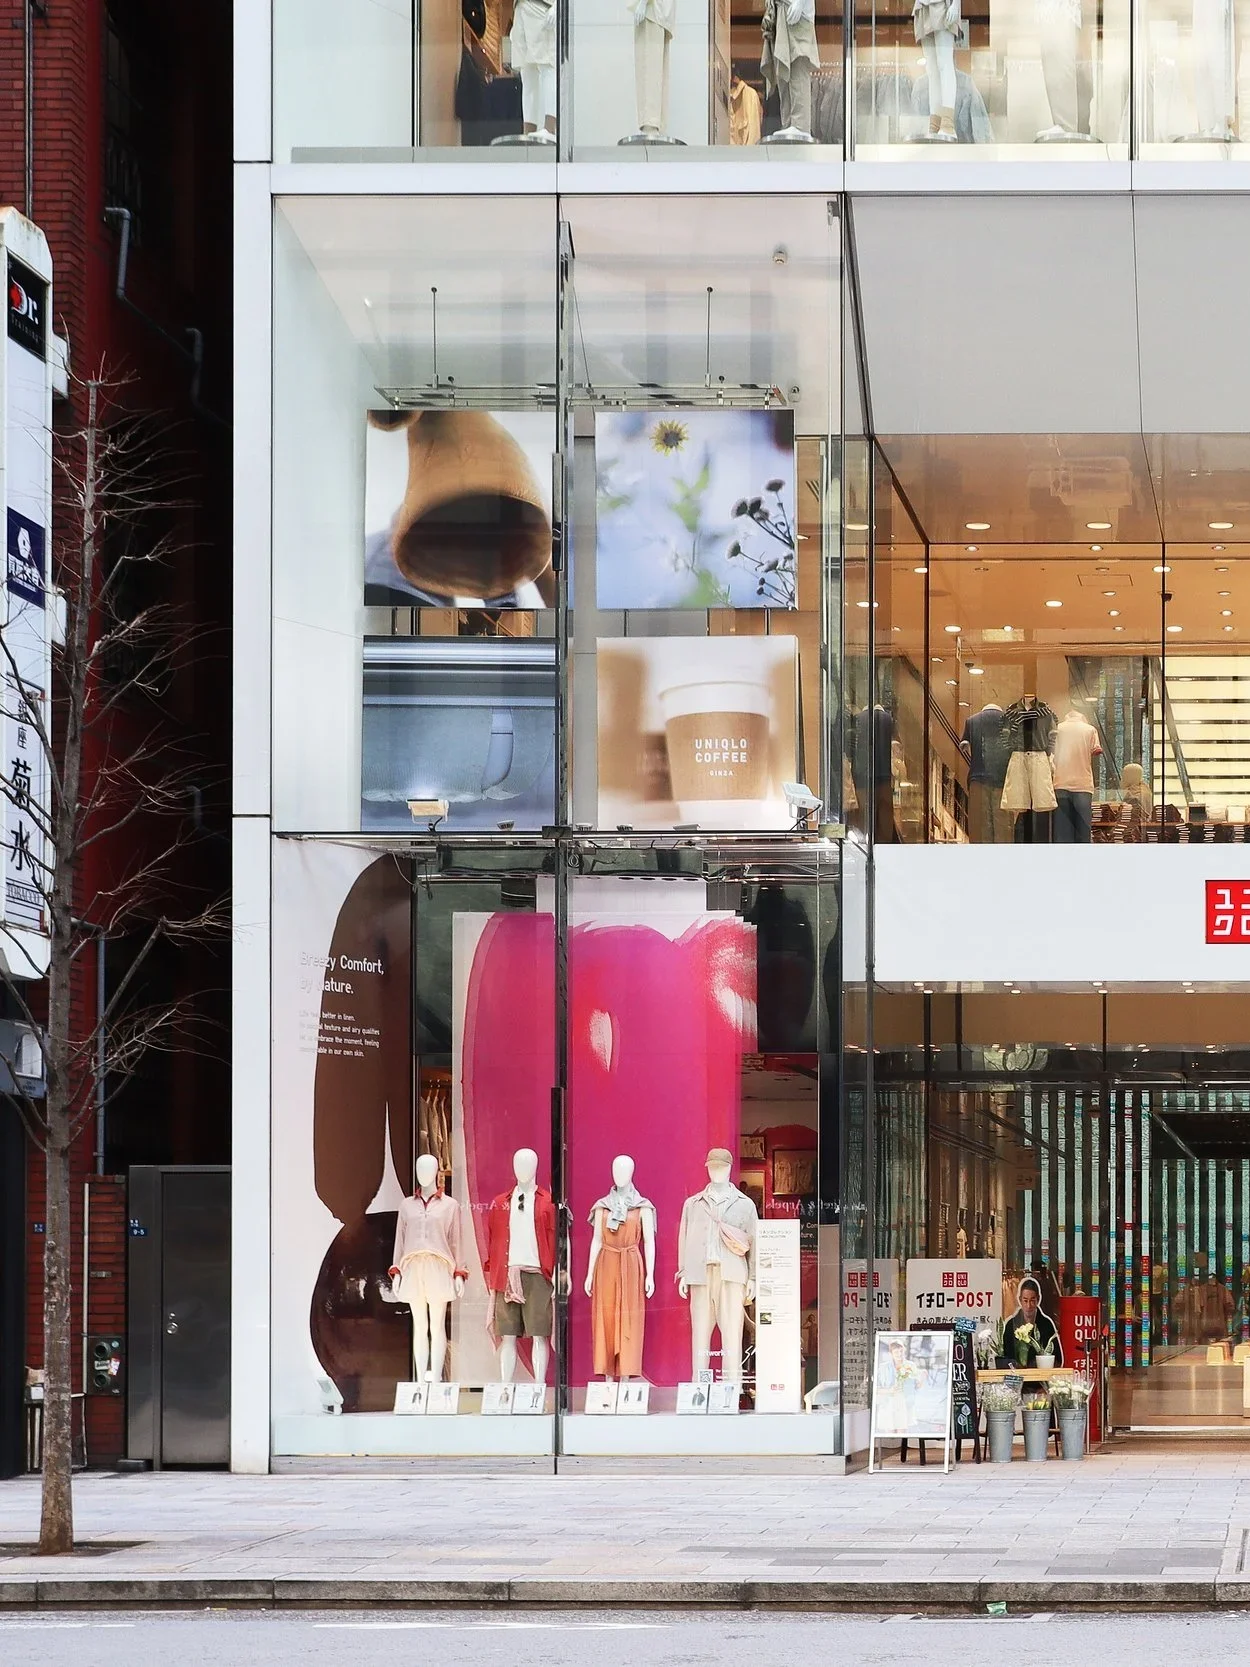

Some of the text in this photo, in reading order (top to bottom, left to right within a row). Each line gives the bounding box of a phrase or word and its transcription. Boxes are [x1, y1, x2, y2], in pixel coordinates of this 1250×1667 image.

[11, 276, 39, 325] Dr.
[695, 738, 748, 751] UNIQLO
[695, 752, 748, 763] COFFEE
[709, 769, 734, 777] GINZA
[340, 955, 385, 976] Comfort,
[1074, 1315, 1096, 1327] UNI
[1074, 1328, 1097, 1343] QLO
